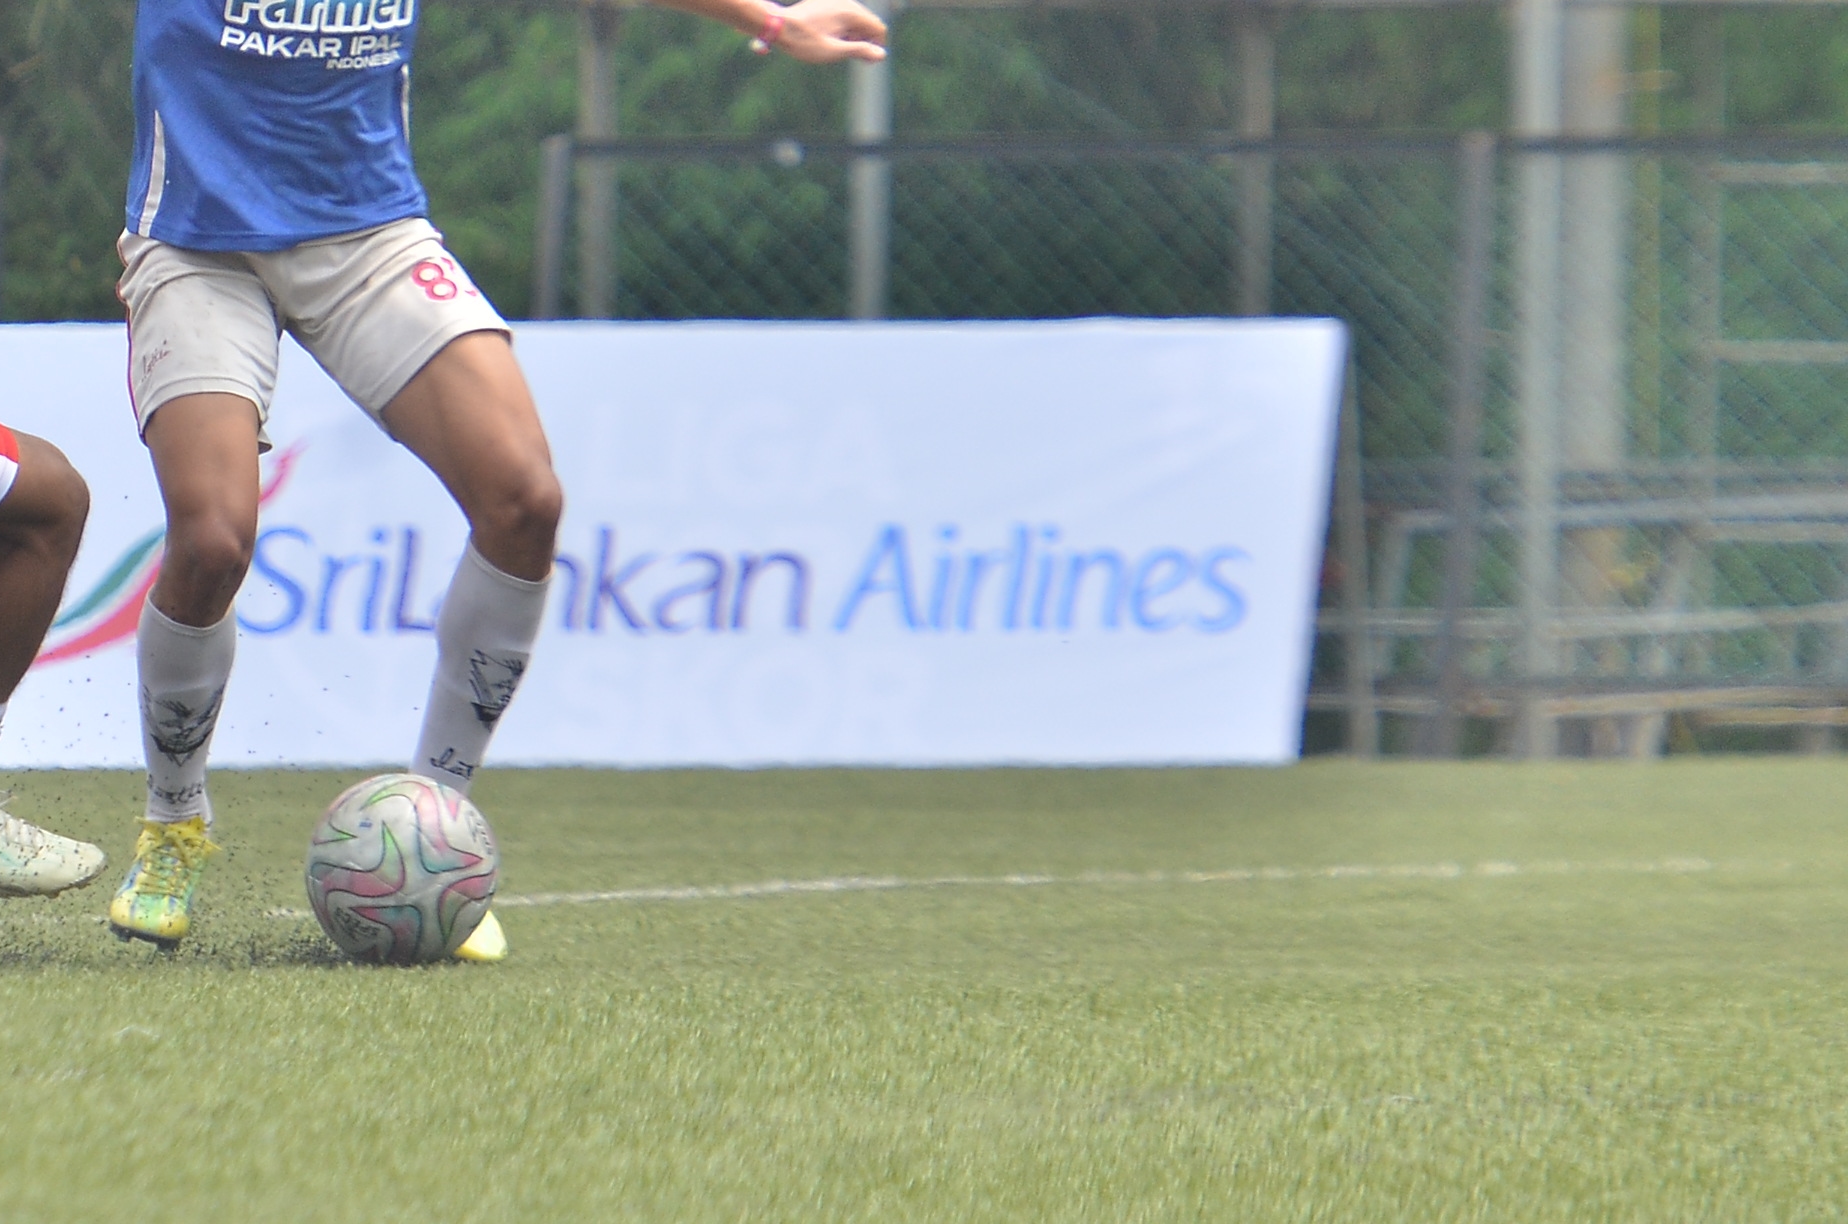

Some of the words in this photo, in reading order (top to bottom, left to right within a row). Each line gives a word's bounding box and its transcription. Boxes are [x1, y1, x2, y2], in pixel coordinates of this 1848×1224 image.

[220, 25, 343, 59] PAKAR
[234, 523, 812, 636] SriLnkan
[832, 521, 1253, 635] Airlines
